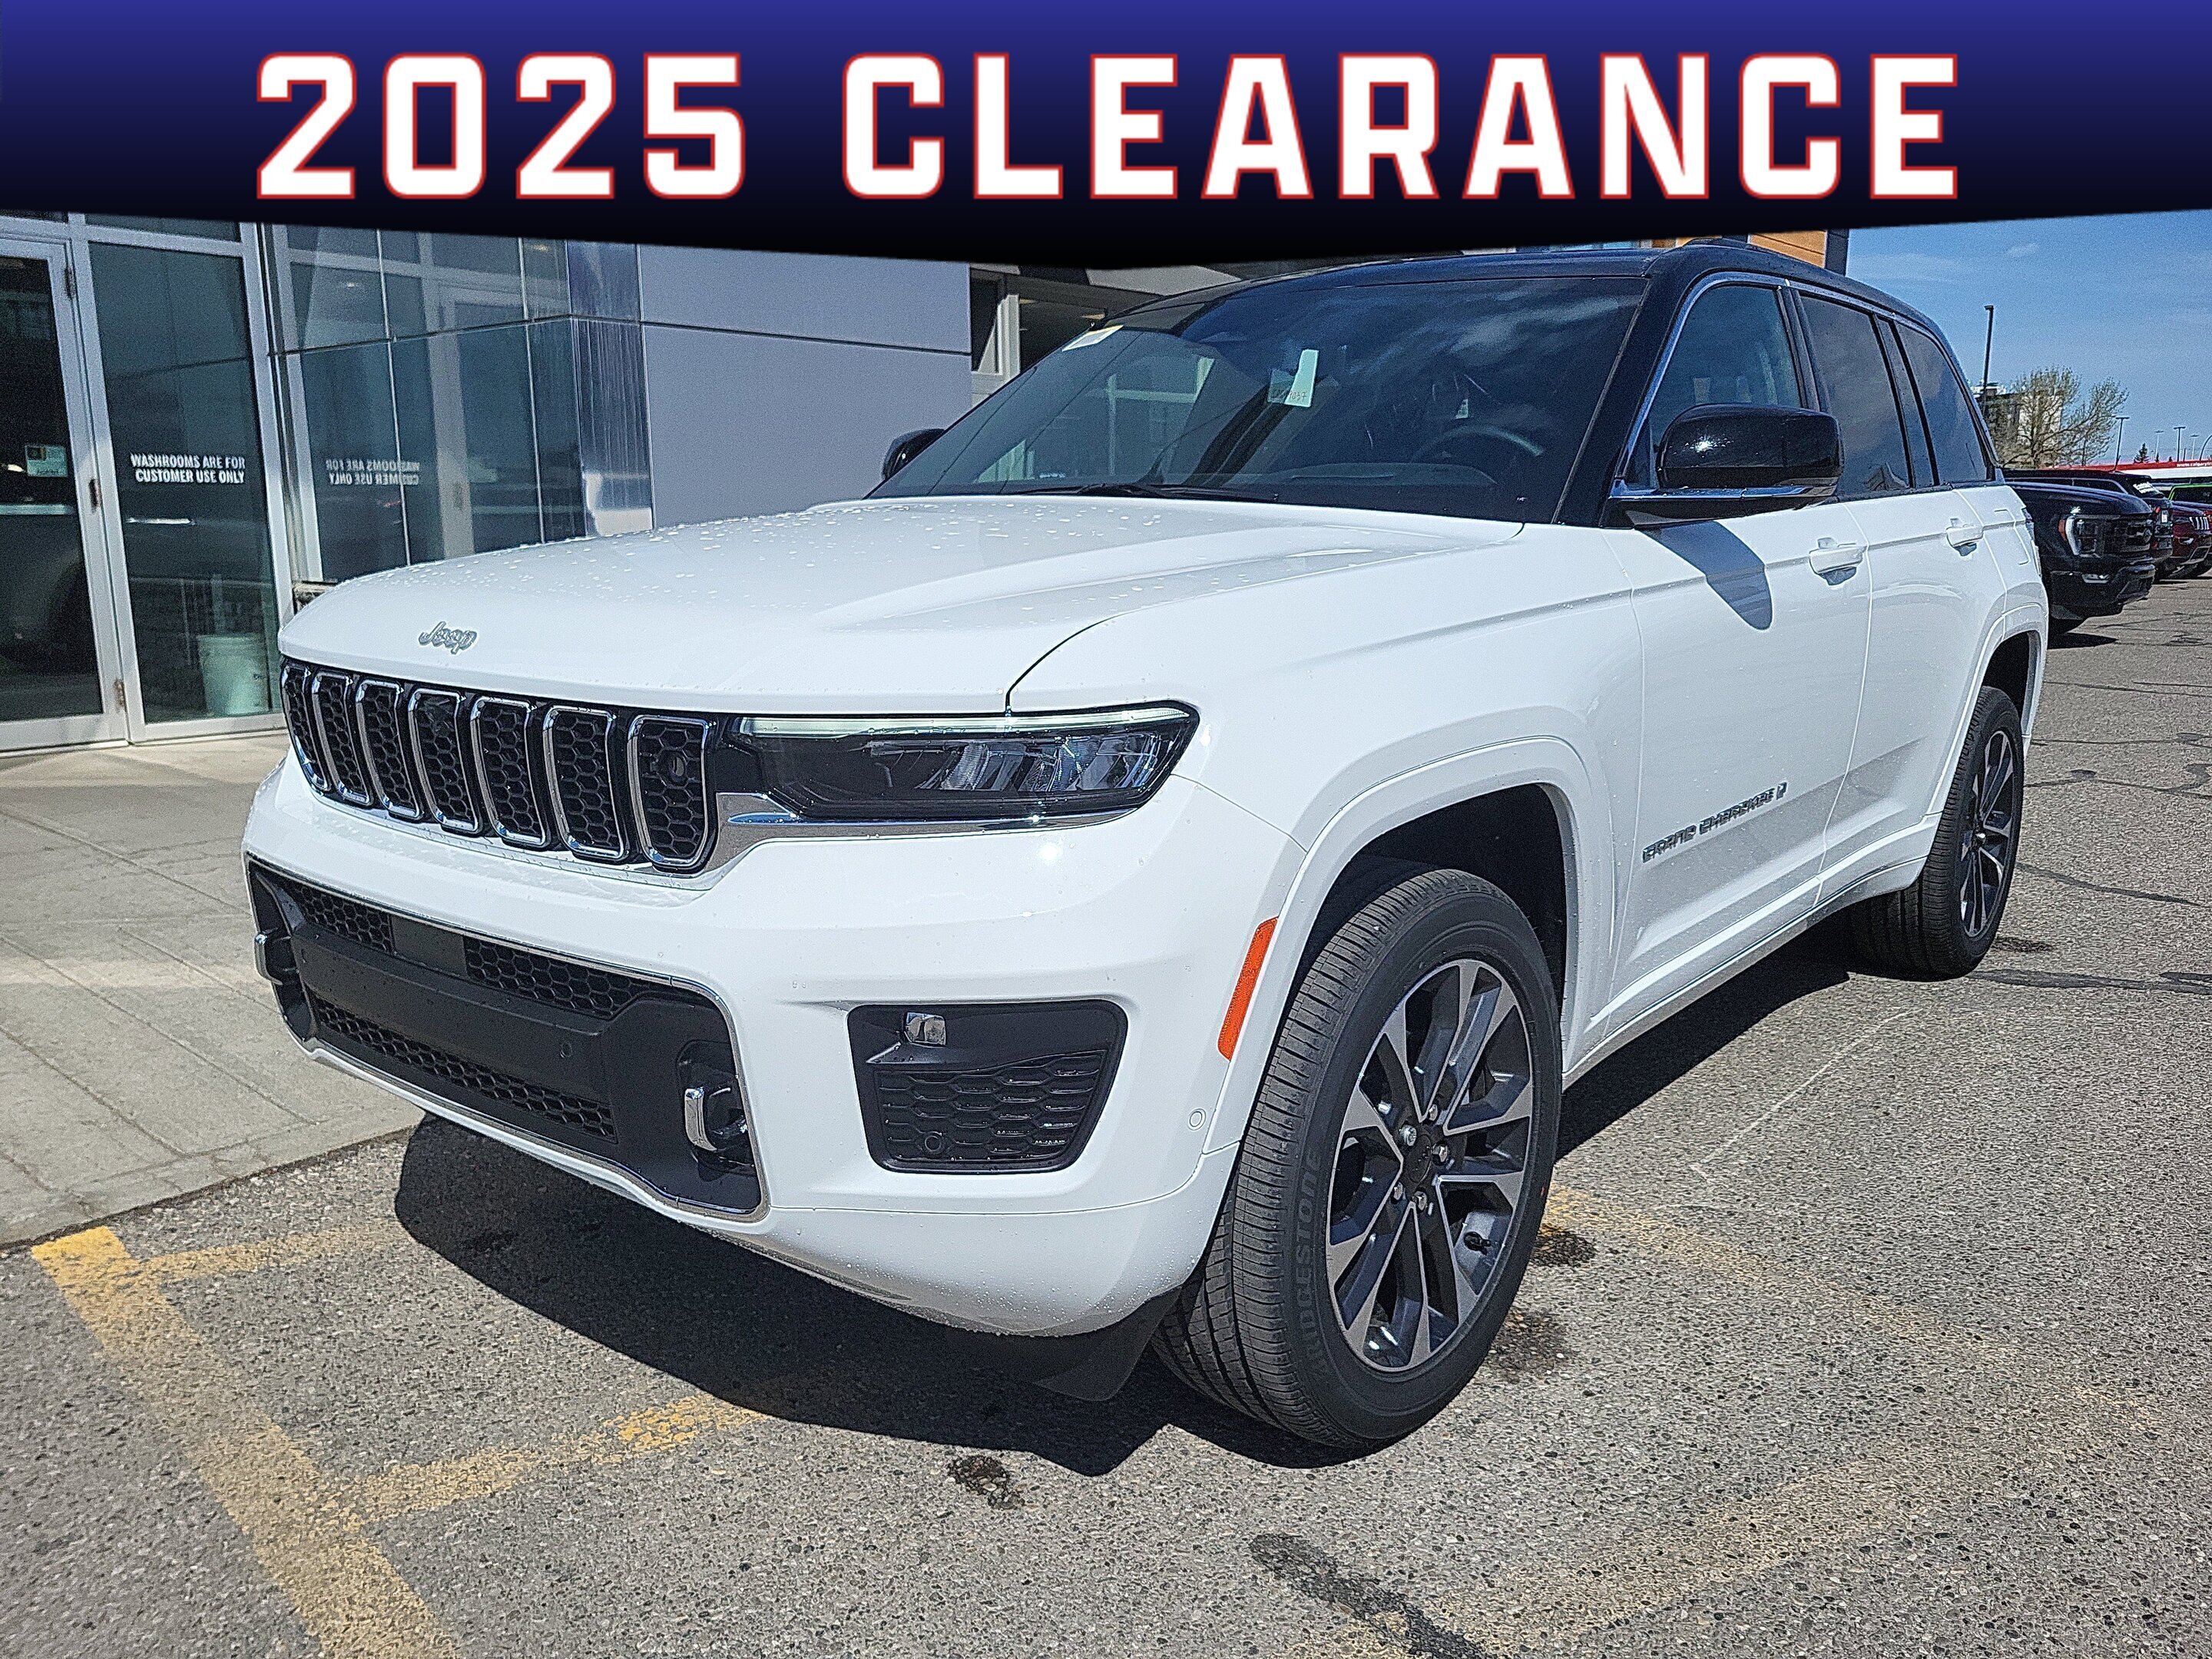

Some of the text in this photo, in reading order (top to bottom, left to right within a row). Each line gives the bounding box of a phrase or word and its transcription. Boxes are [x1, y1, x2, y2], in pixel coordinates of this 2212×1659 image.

[130, 452, 246, 469] WASHROOMS ARE FOR
[135, 468, 245, 484] CUSTOMER USE ONLY
[419, 621, 477, 654] Jeep
[1642, 786, 1776, 863] GRAND CHEROKEE
